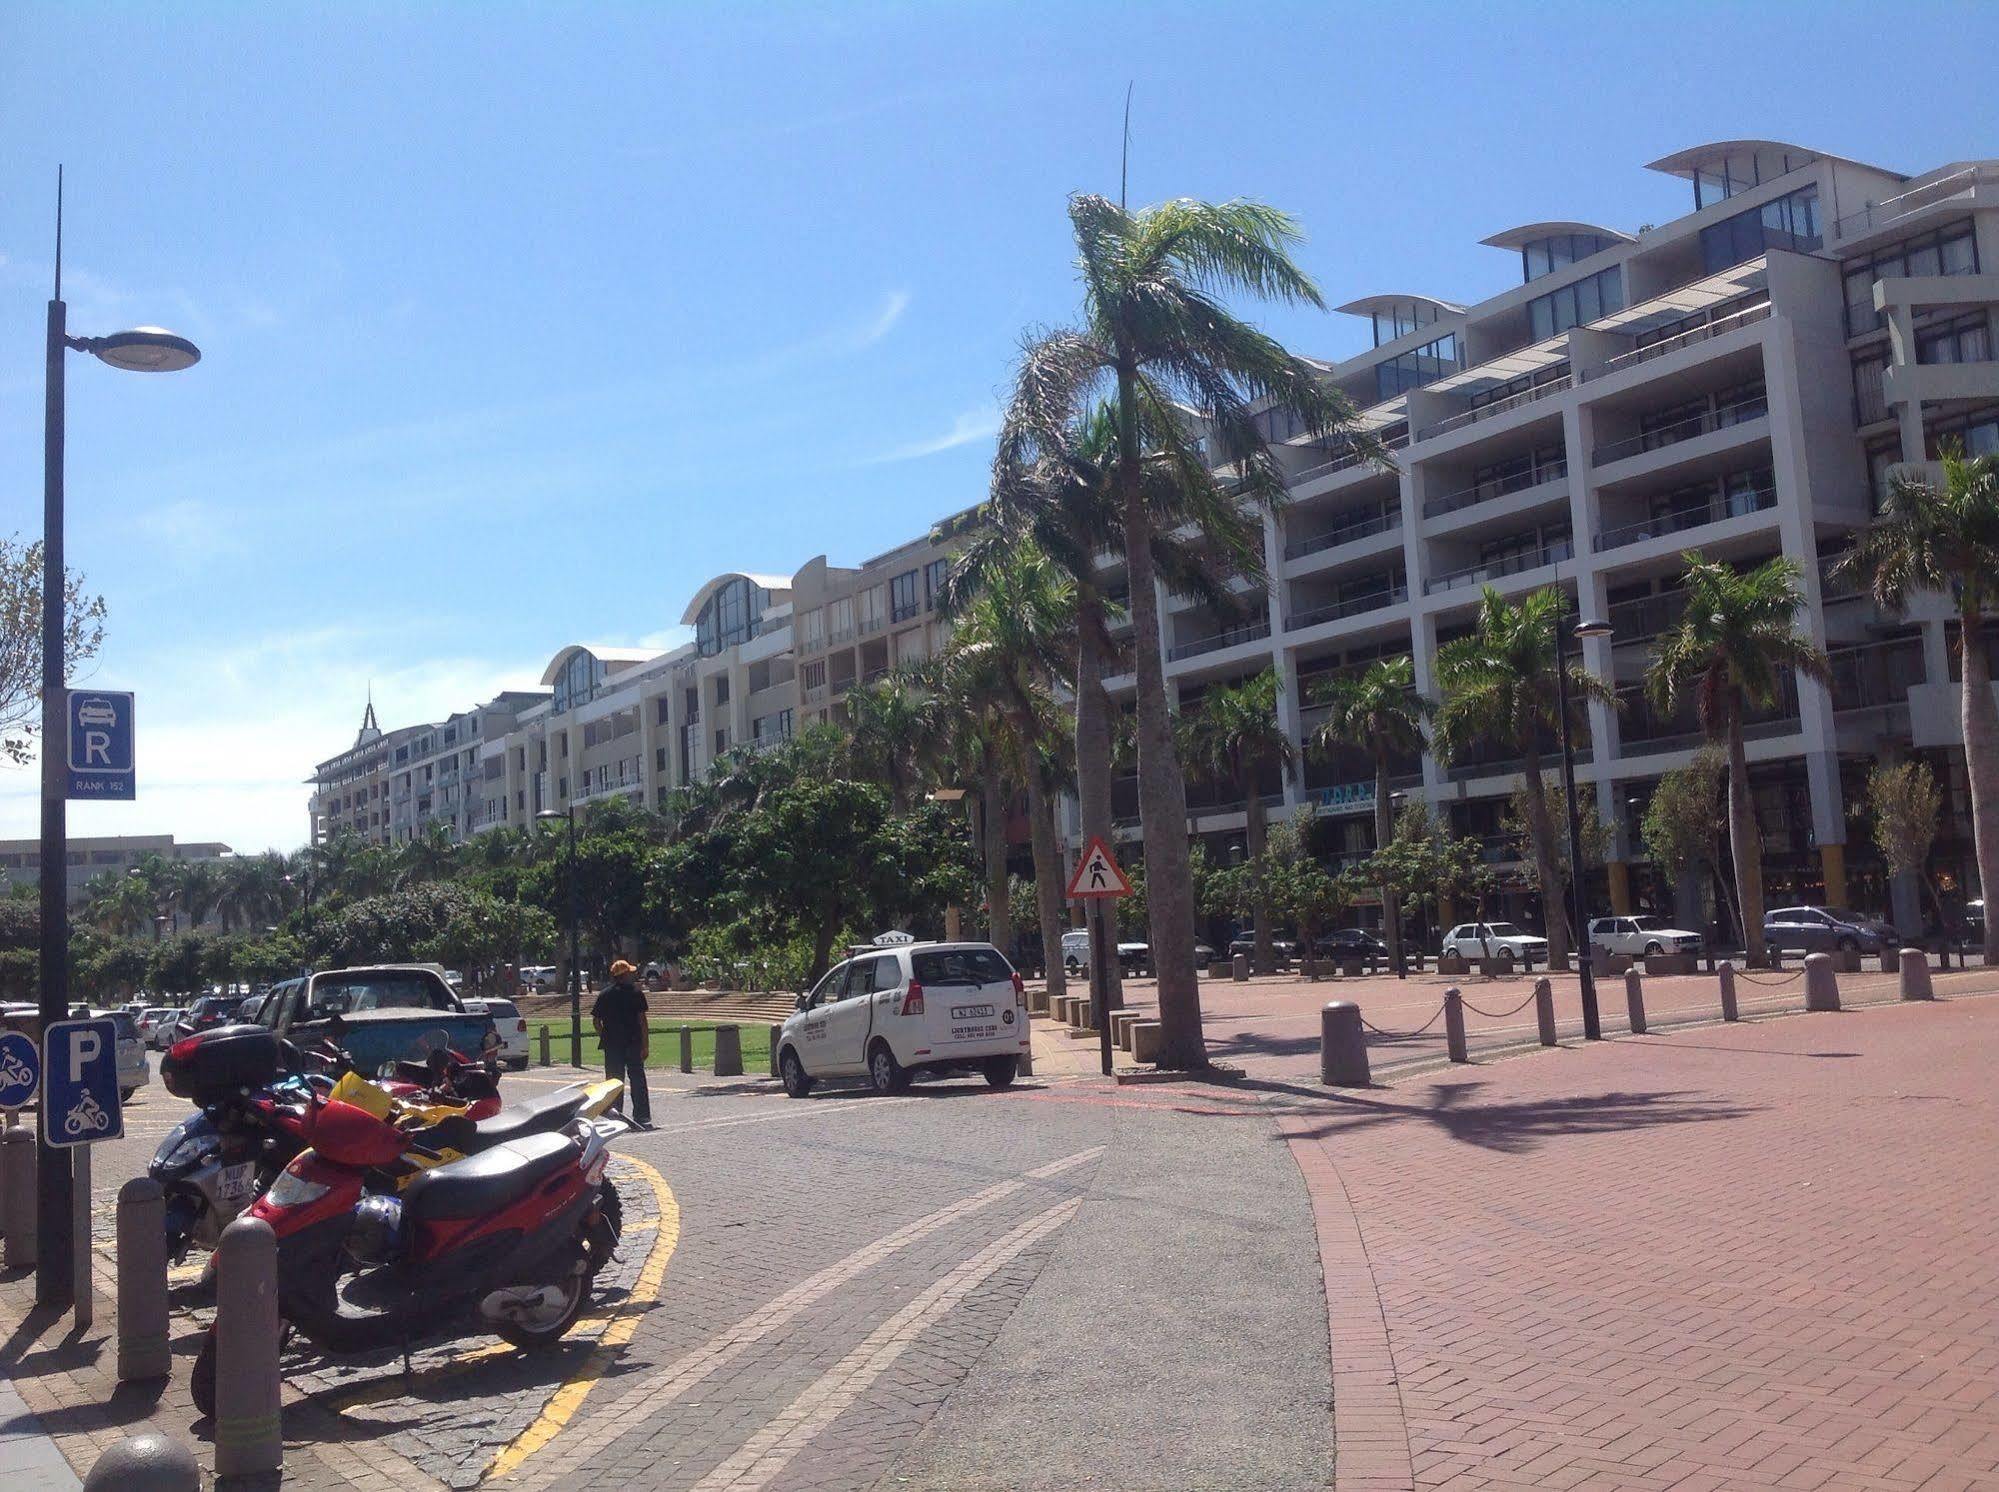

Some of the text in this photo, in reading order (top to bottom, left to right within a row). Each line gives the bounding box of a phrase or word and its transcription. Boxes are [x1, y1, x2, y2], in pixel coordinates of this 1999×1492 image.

[85, 730, 112, 765] R
[76, 781, 124, 792] RANK 152
[879, 935, 908, 944] TAXI
[69, 1030, 101, 1082] P
